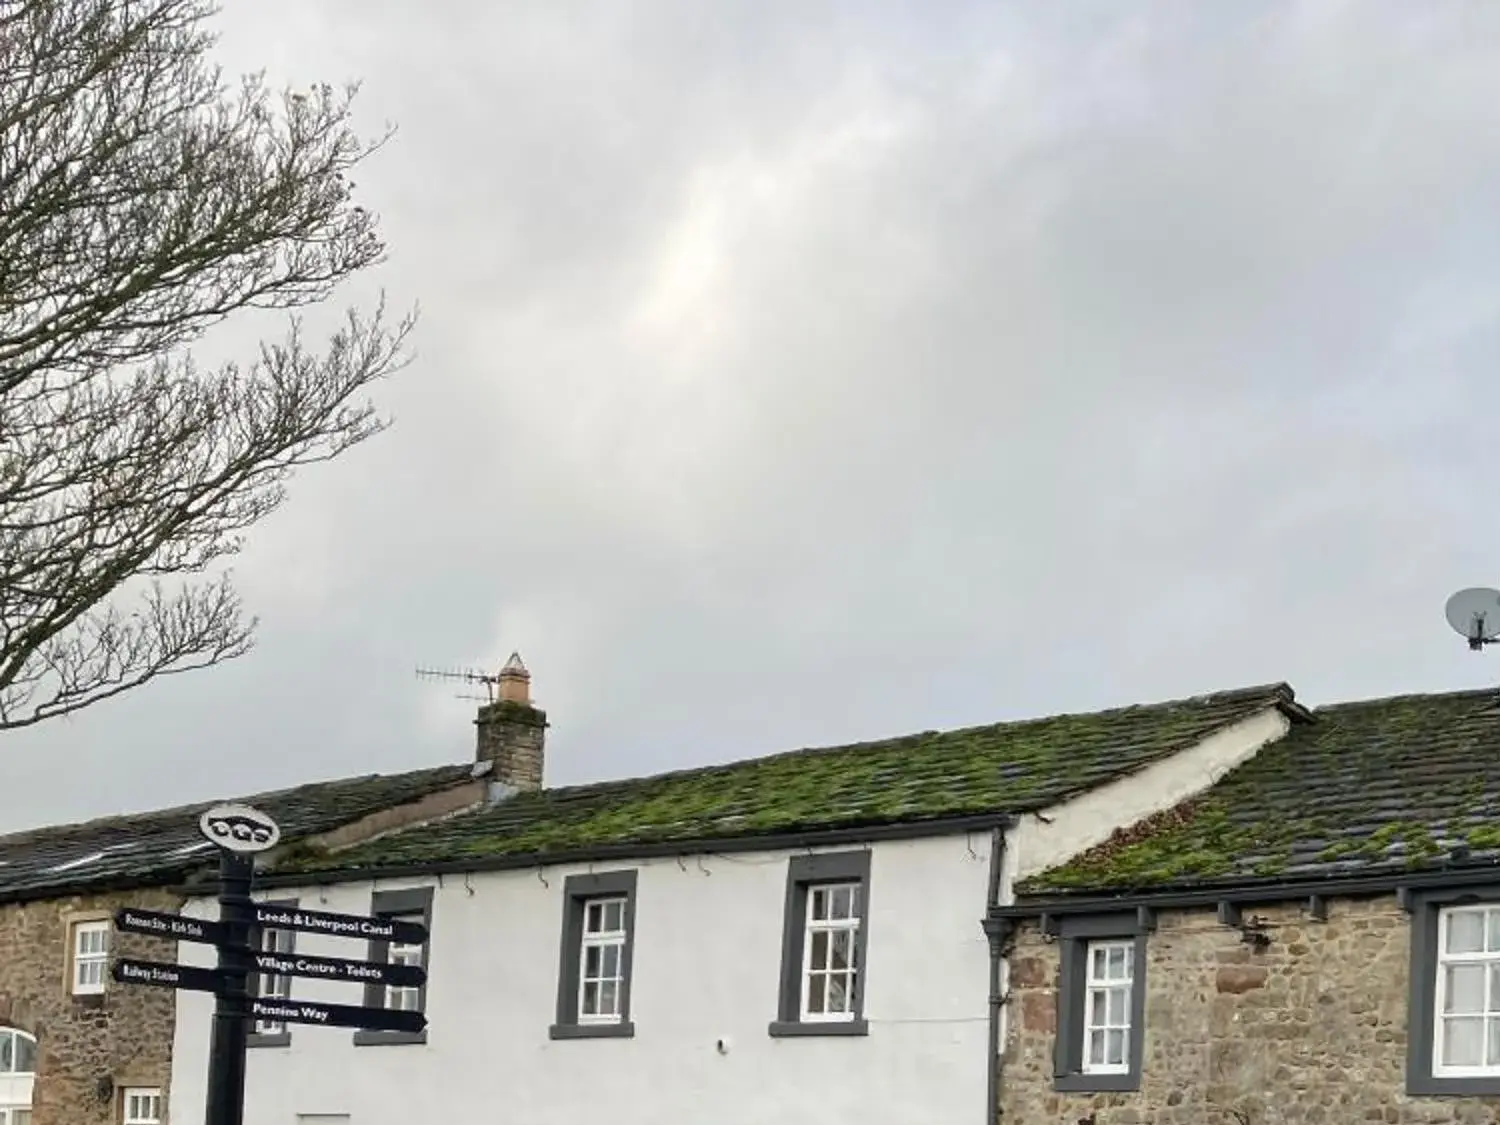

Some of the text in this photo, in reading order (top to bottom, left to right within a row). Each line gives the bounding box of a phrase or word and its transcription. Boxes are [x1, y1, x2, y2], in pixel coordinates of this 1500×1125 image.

[257, 910, 393, 935] Leeds & Liverpool Canal
[256, 956, 294, 971] Village
[296, 959, 336, 974] Centre
[345, 965, 382, 979] Toilets
[253, 1003, 329, 1021] Pennine Way
